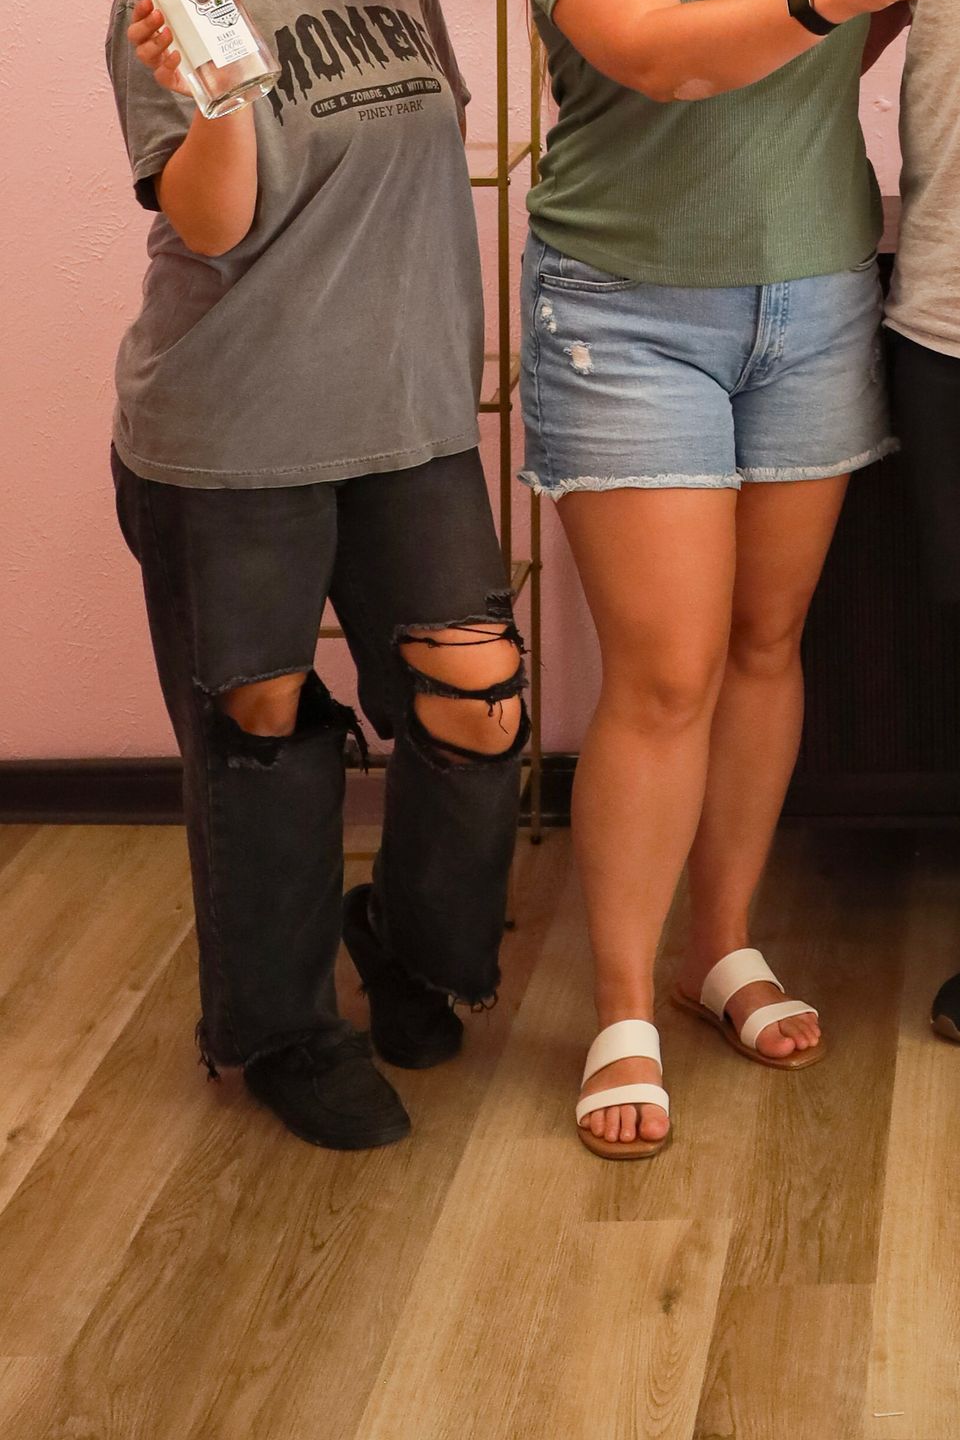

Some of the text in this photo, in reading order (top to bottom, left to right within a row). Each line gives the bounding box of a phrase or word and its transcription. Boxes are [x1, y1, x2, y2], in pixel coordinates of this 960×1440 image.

[315, 100, 337, 114] LIKE
[340, 96, 348, 107] A
[351, 88, 386, 102] ZOMBIE,
[387, 84, 404, 96] BUT
[407, 80, 425, 92] WITH
[358, 100, 424, 121] PINEY PARK
